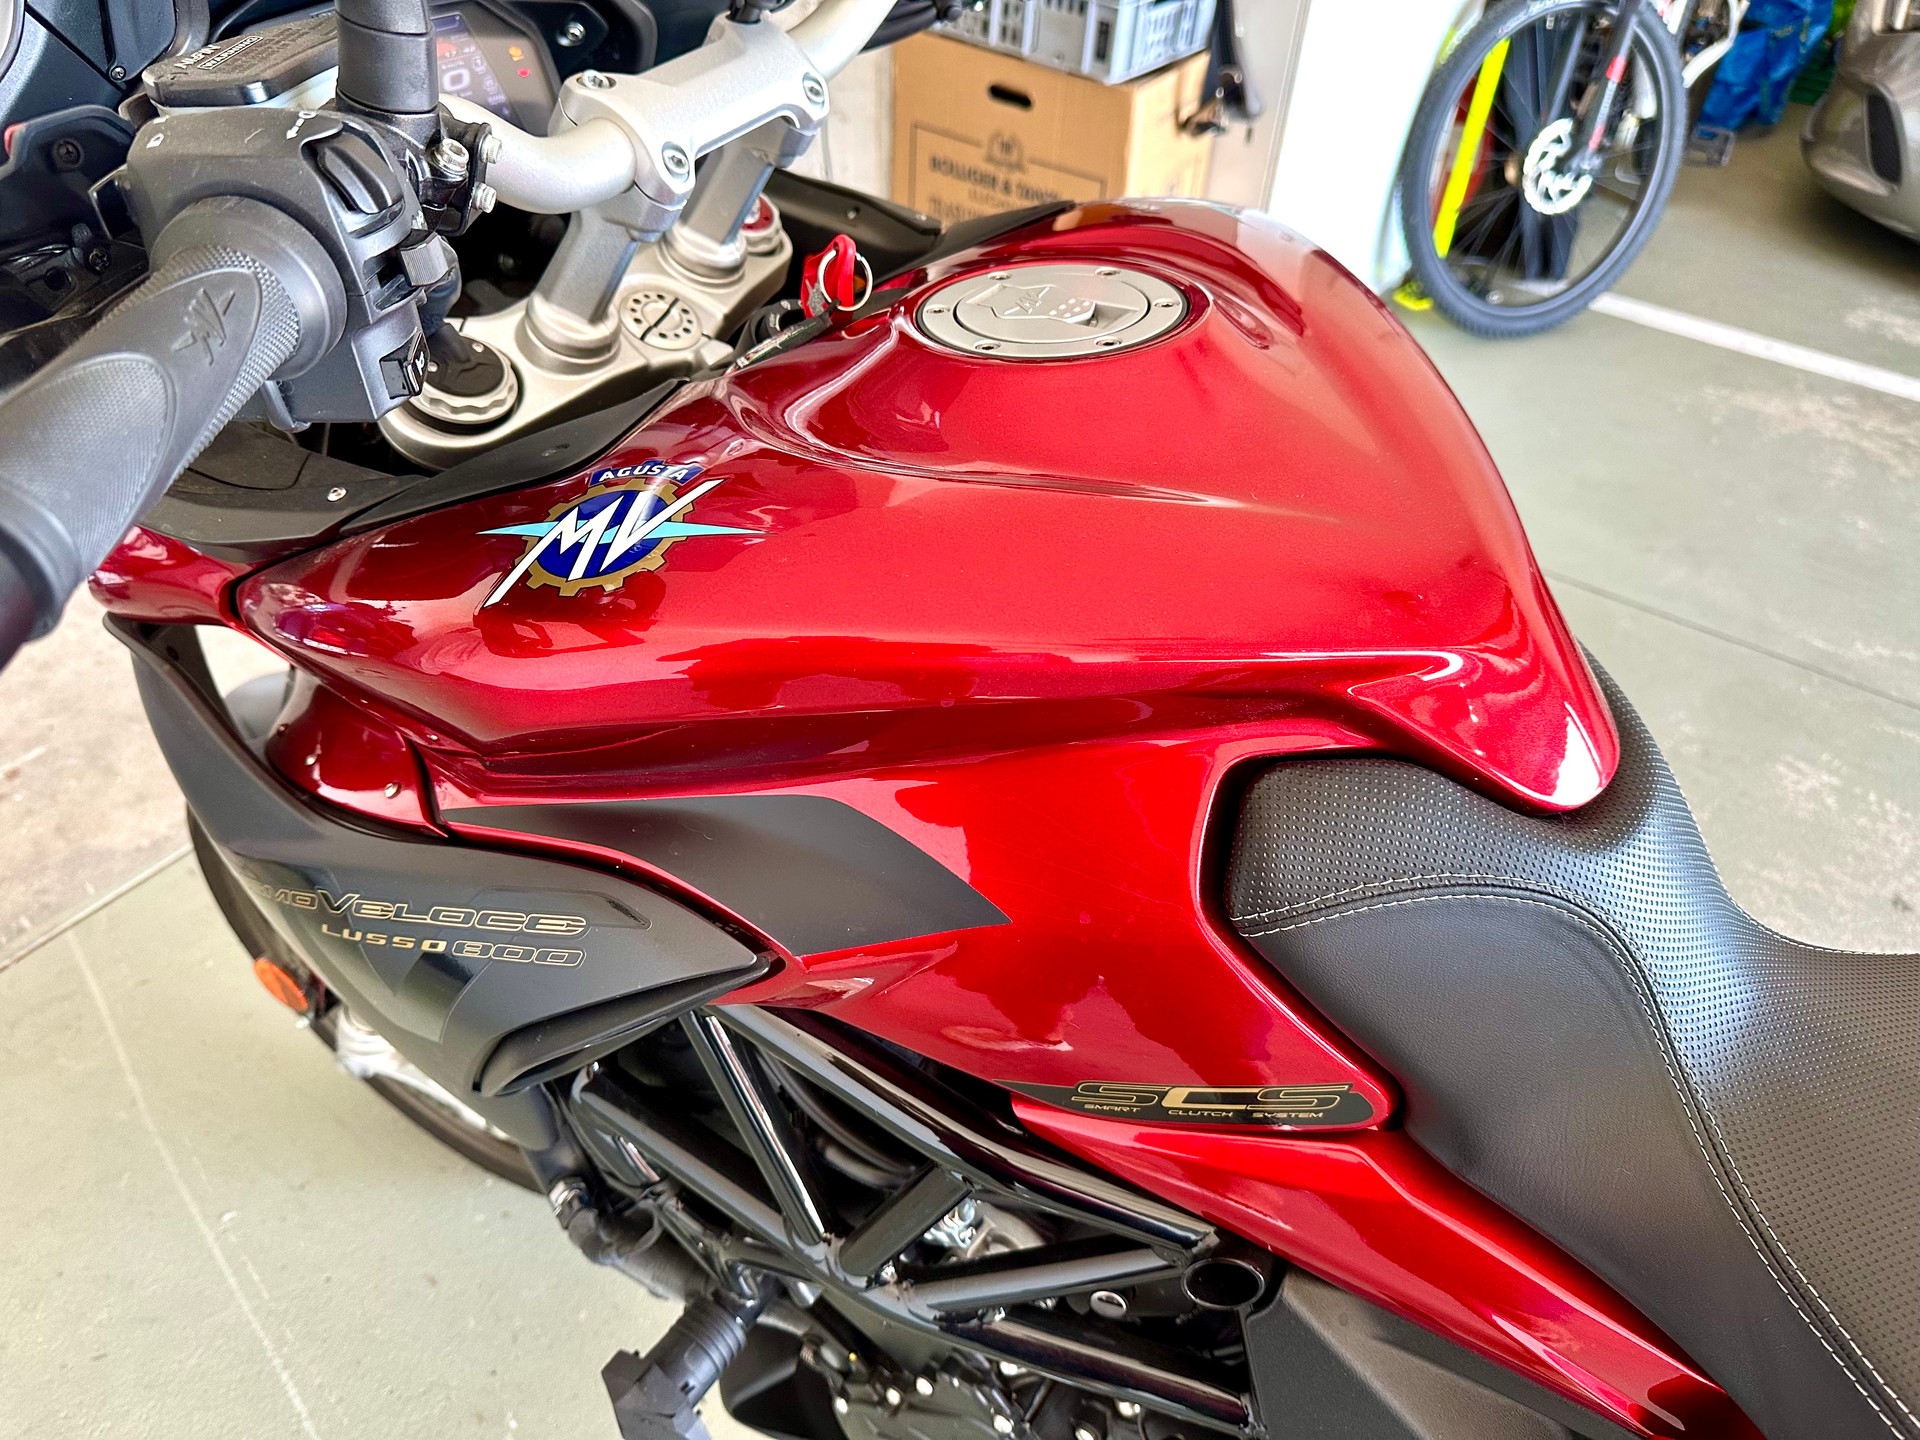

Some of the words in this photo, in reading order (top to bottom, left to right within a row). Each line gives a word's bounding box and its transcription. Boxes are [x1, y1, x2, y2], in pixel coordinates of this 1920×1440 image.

[598, 463, 690, 482] AGUSTA
[321, 923, 447, 955] LUSSO
[451, 941, 585, 968] 800
[1071, 1080, 1350, 1110] SCS
[1083, 1103, 1141, 1113] SMART
[1168, 1109, 1234, 1118] CLUTCH
[1252, 1111, 1324, 1119] SYSTEM
